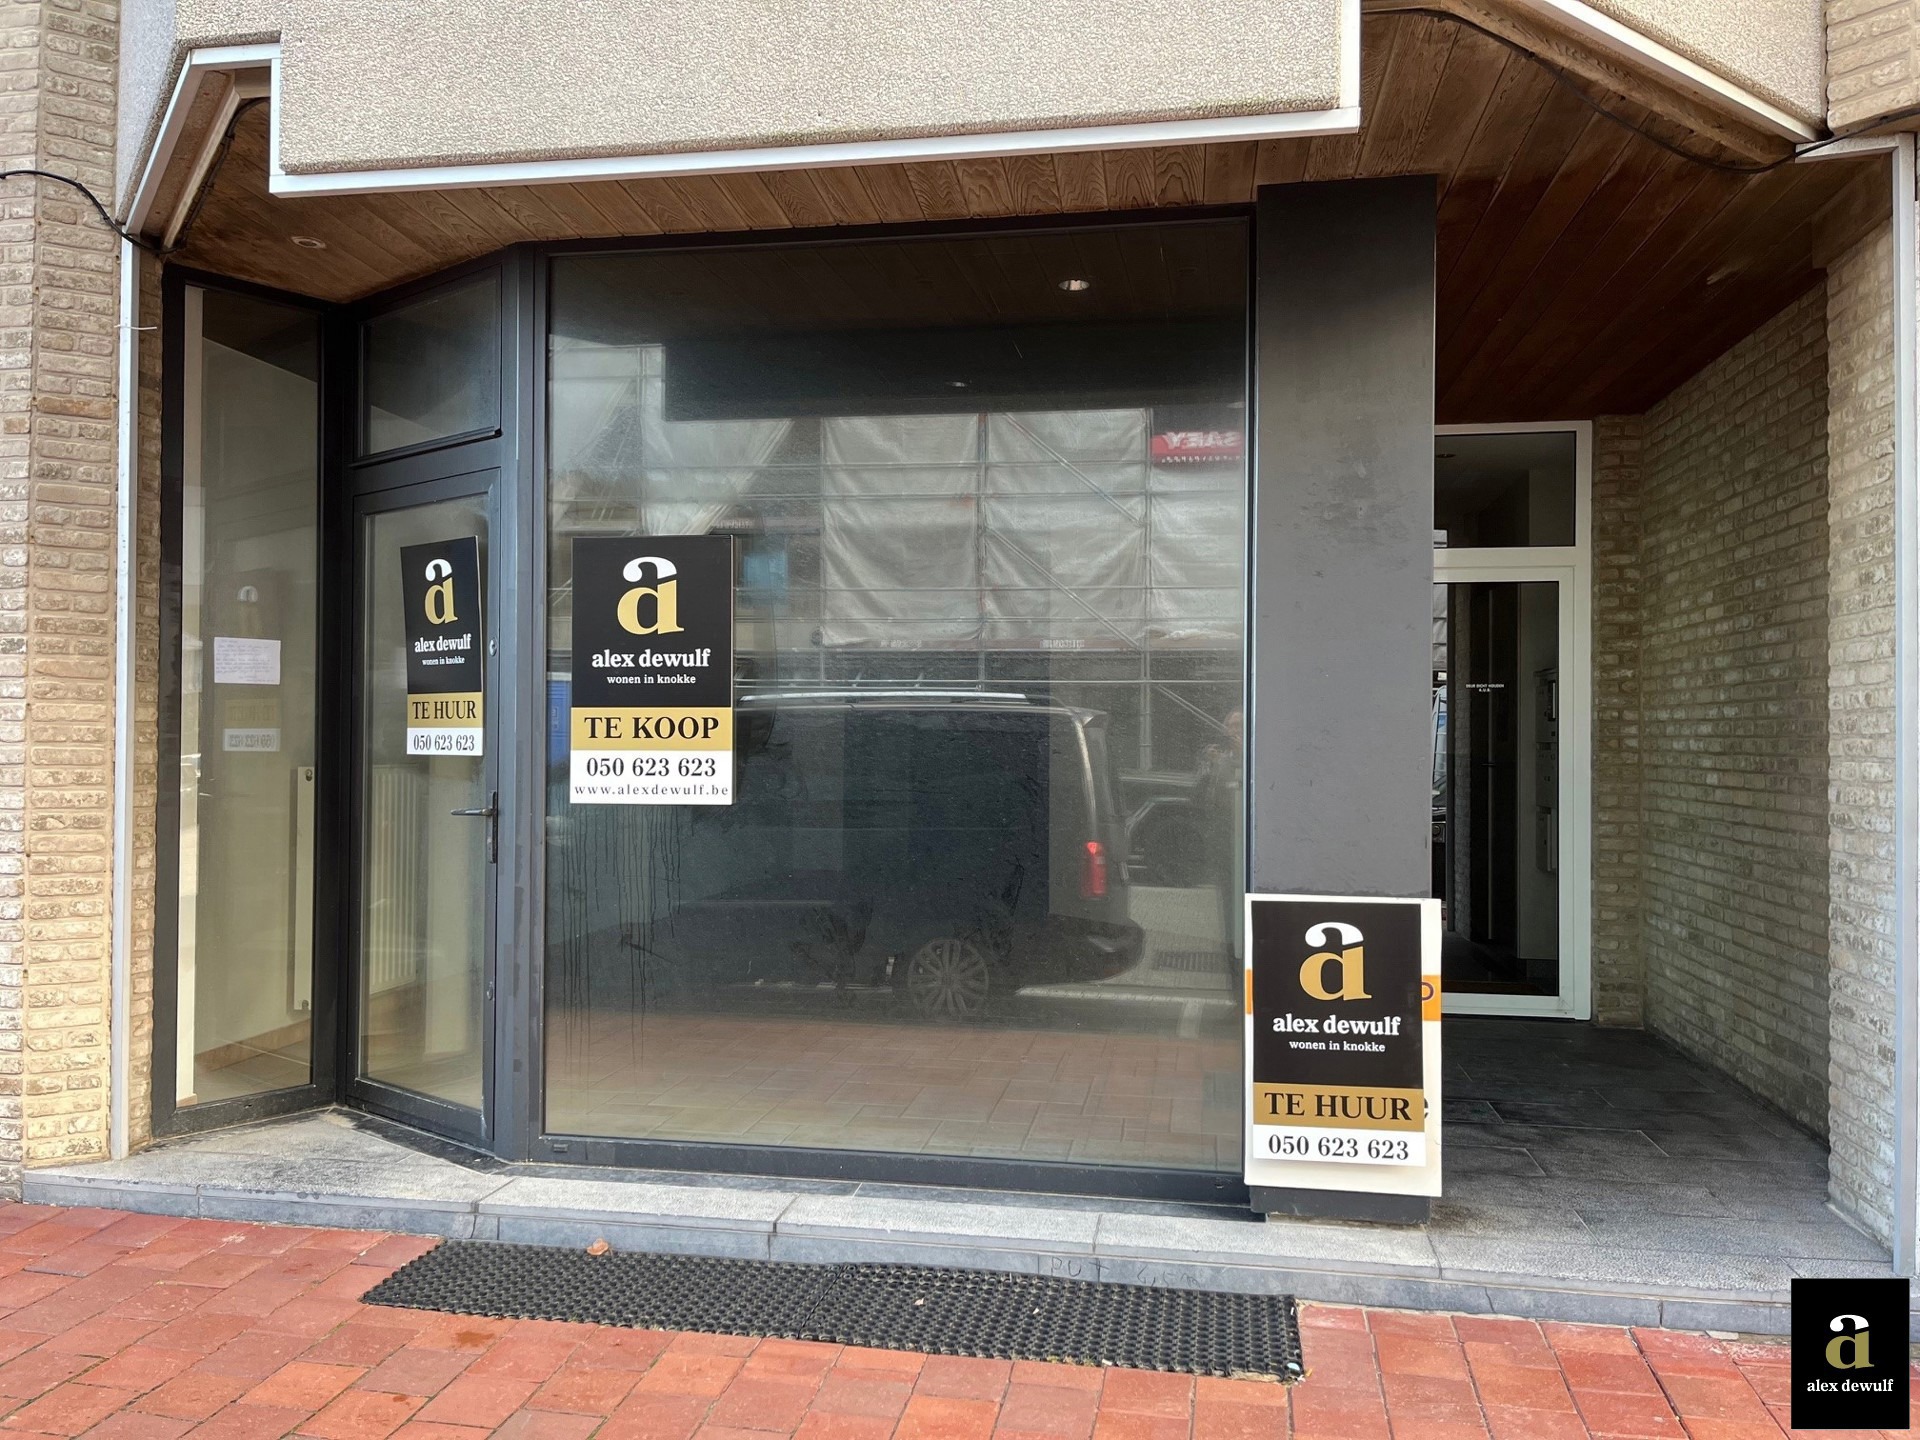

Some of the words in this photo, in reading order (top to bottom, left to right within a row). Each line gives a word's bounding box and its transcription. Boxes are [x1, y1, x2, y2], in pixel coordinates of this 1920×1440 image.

[414, 636, 435, 653] alex
[436, 633, 472, 651] dewulf
[422, 657, 439, 666] wonen
[439, 656, 445, 665] in
[446, 656, 465, 665] knokke
[591, 649, 636, 668] alex
[638, 648, 711, 668] dewulf
[606, 675, 641, 684] wonen
[644, 674, 654, 684] in
[657, 674, 696, 684] knokke
[412, 700, 430, 719] TE
[434, 700, 477, 720] HUUR
[584, 717, 623, 739] TE
[632, 716, 719, 739] KOOP
[413, 734, 432, 751] 050
[434, 734, 453, 751] 623
[455, 734, 475, 752] 623
[586, 757, 624, 777] 050
[632, 757, 670, 777] 623
[678, 757, 716, 777] 623
[574, 784, 729, 796] www.alexdewulf.be
[1273, 1013, 1320, 1033] alex
[1323, 1015, 1401, 1036] dewulf
[1289, 1040, 1326, 1050] wonen
[1329, 1040, 1340, 1051] in
[1343, 1041, 1386, 1052] knokke
[1264, 1092, 1306, 1116] TE
[1315, 1094, 1412, 1121] HUUR
[1268, 1134, 1309, 1155] 050
[1318, 1136, 1359, 1158] 623
[1368, 1139, 1409, 1161] 623
